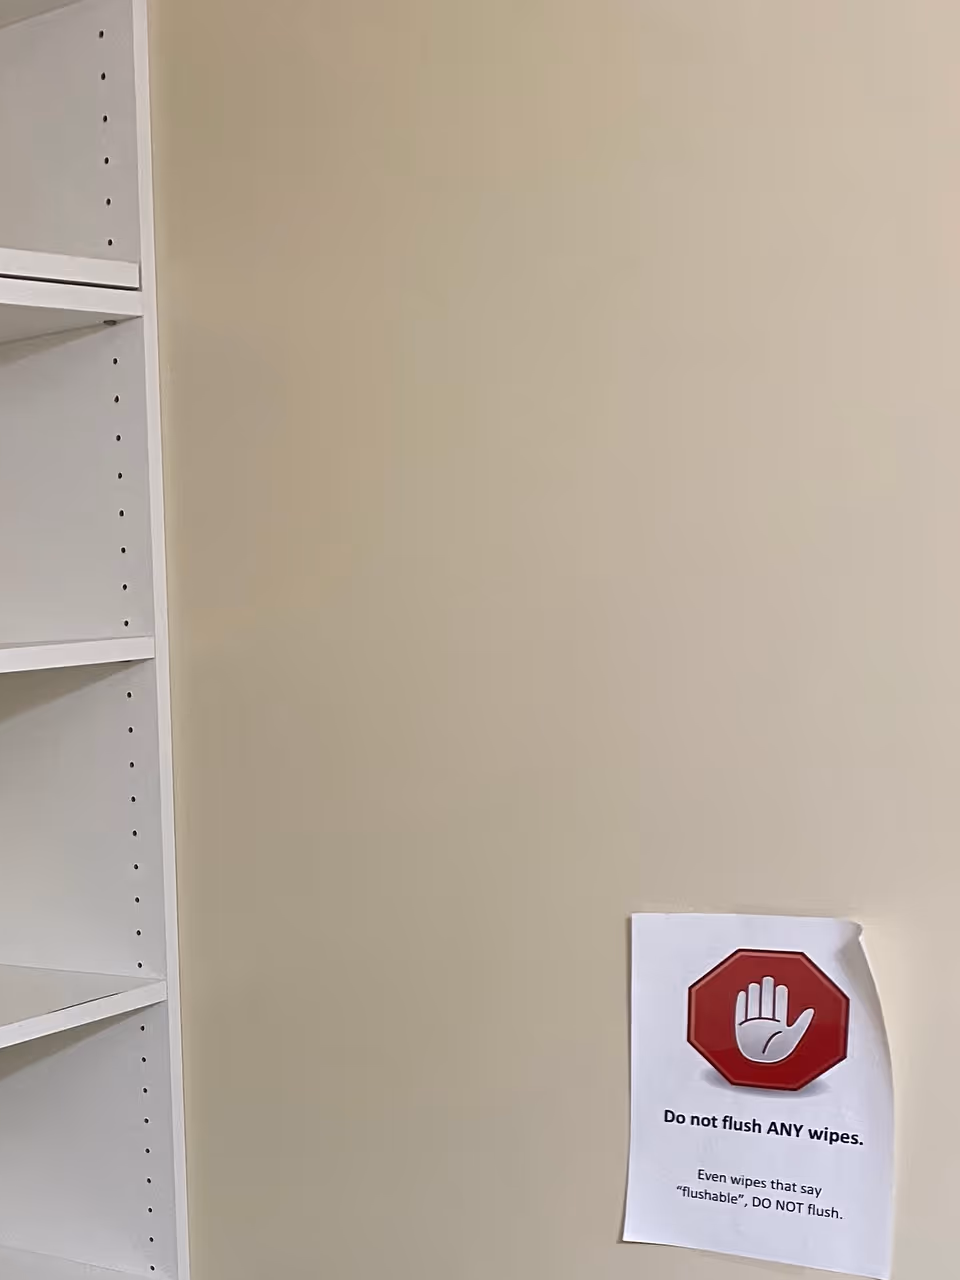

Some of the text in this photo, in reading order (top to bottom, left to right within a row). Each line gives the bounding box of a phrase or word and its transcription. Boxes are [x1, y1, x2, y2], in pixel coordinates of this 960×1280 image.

[664, 1110, 864, 1145] Do not flush ANY wipes.
[697, 1169, 823, 1198] Even wipes that say
[752, 1196, 772, 1208] DO
[775, 1200, 805, 1213] NOT
[807, 1204, 843, 1219] flush.
